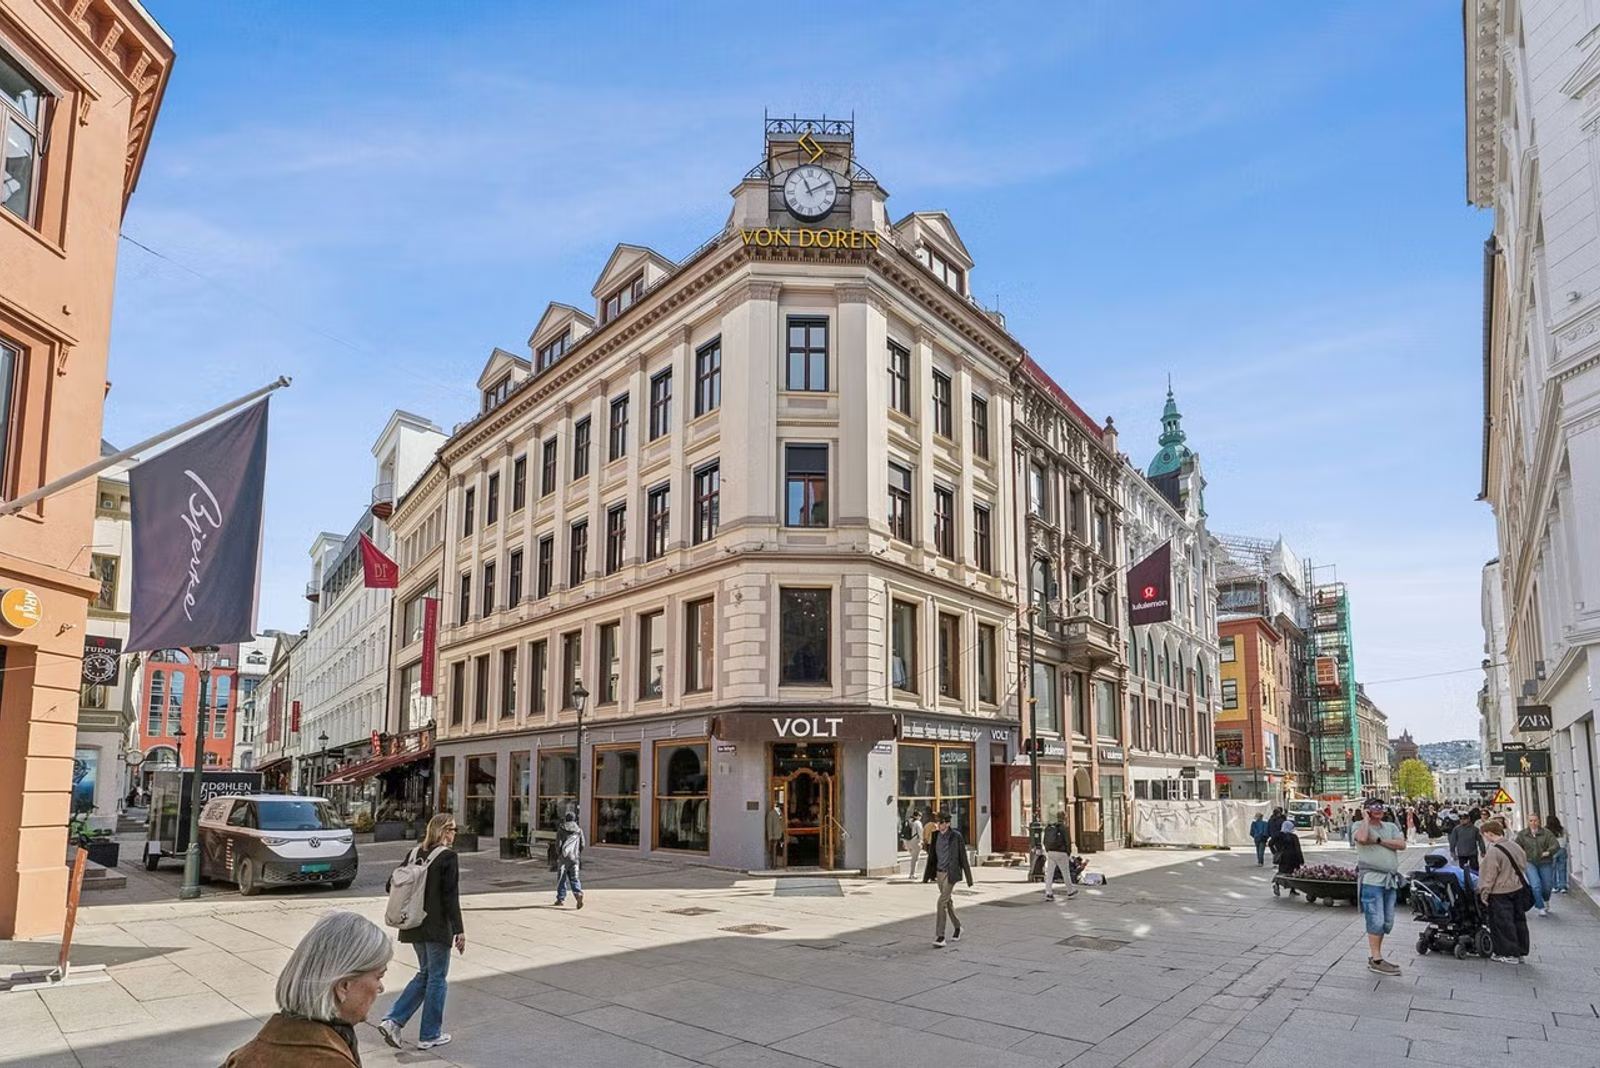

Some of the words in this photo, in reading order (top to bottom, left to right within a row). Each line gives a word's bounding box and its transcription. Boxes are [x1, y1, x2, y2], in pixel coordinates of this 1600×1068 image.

[739, 228, 791, 247] VON
[799, 228, 880, 250] DOREN
[181, 469, 223, 622] Bjerke
[1131, 600, 1169, 610] lululemon
[85, 646, 117, 655] TUDOR
[1519, 714, 1551, 728] ZARA
[771, 718, 844, 737] VOLT
[990, 729, 1009, 740] VOLT
[209, 781, 252, 791] DØHLEN
